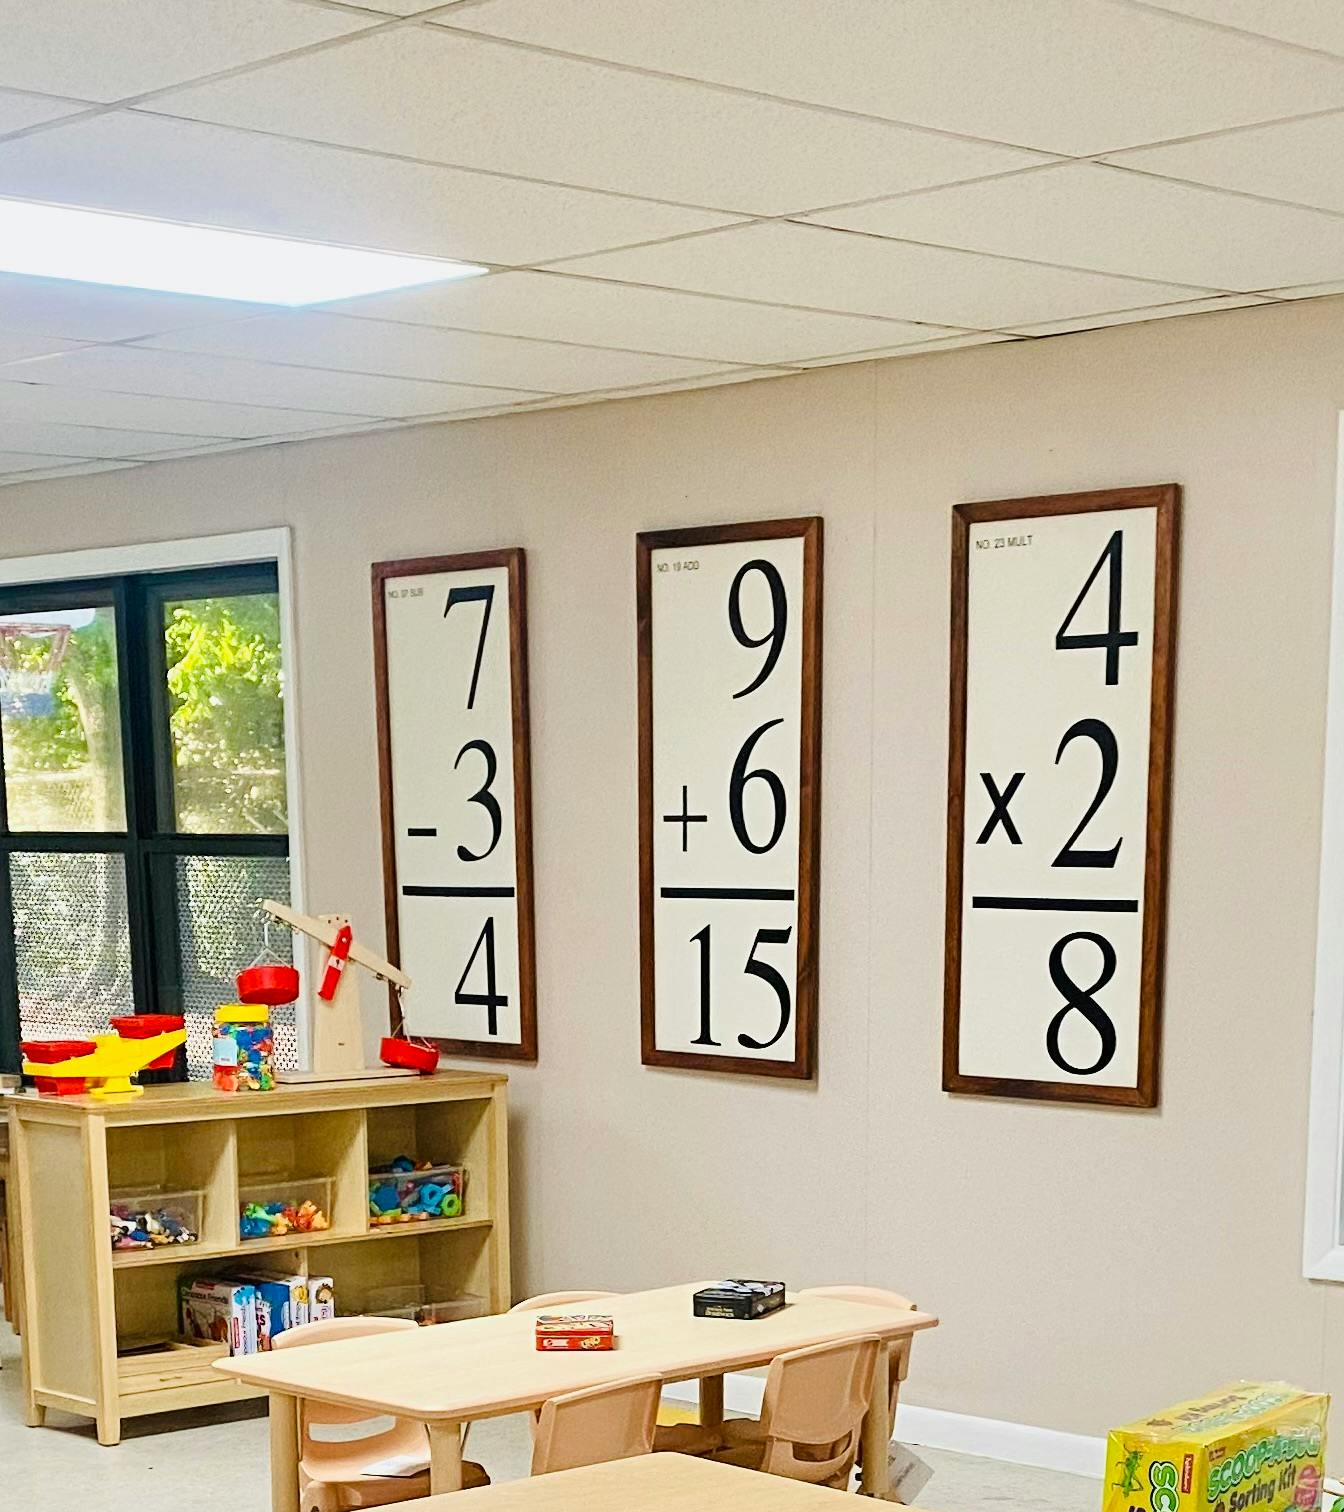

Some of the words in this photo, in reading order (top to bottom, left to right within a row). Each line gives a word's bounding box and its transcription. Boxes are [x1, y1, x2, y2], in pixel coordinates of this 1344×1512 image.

[444, 584, 495, 709] 7
[729, 559, 787, 699] 9
[1056, 529, 1138, 685] 4
[454, 739, 502, 861] 3
[729, 718, 786, 855] 6
[1051, 718, 1123, 868] 2
[455, 916, 509, 1035] 4
[690, 925, 792, 1050] 15
[1046, 931, 1117, 1075] 8
[1278, 1463, 1297, 1492] Kit
